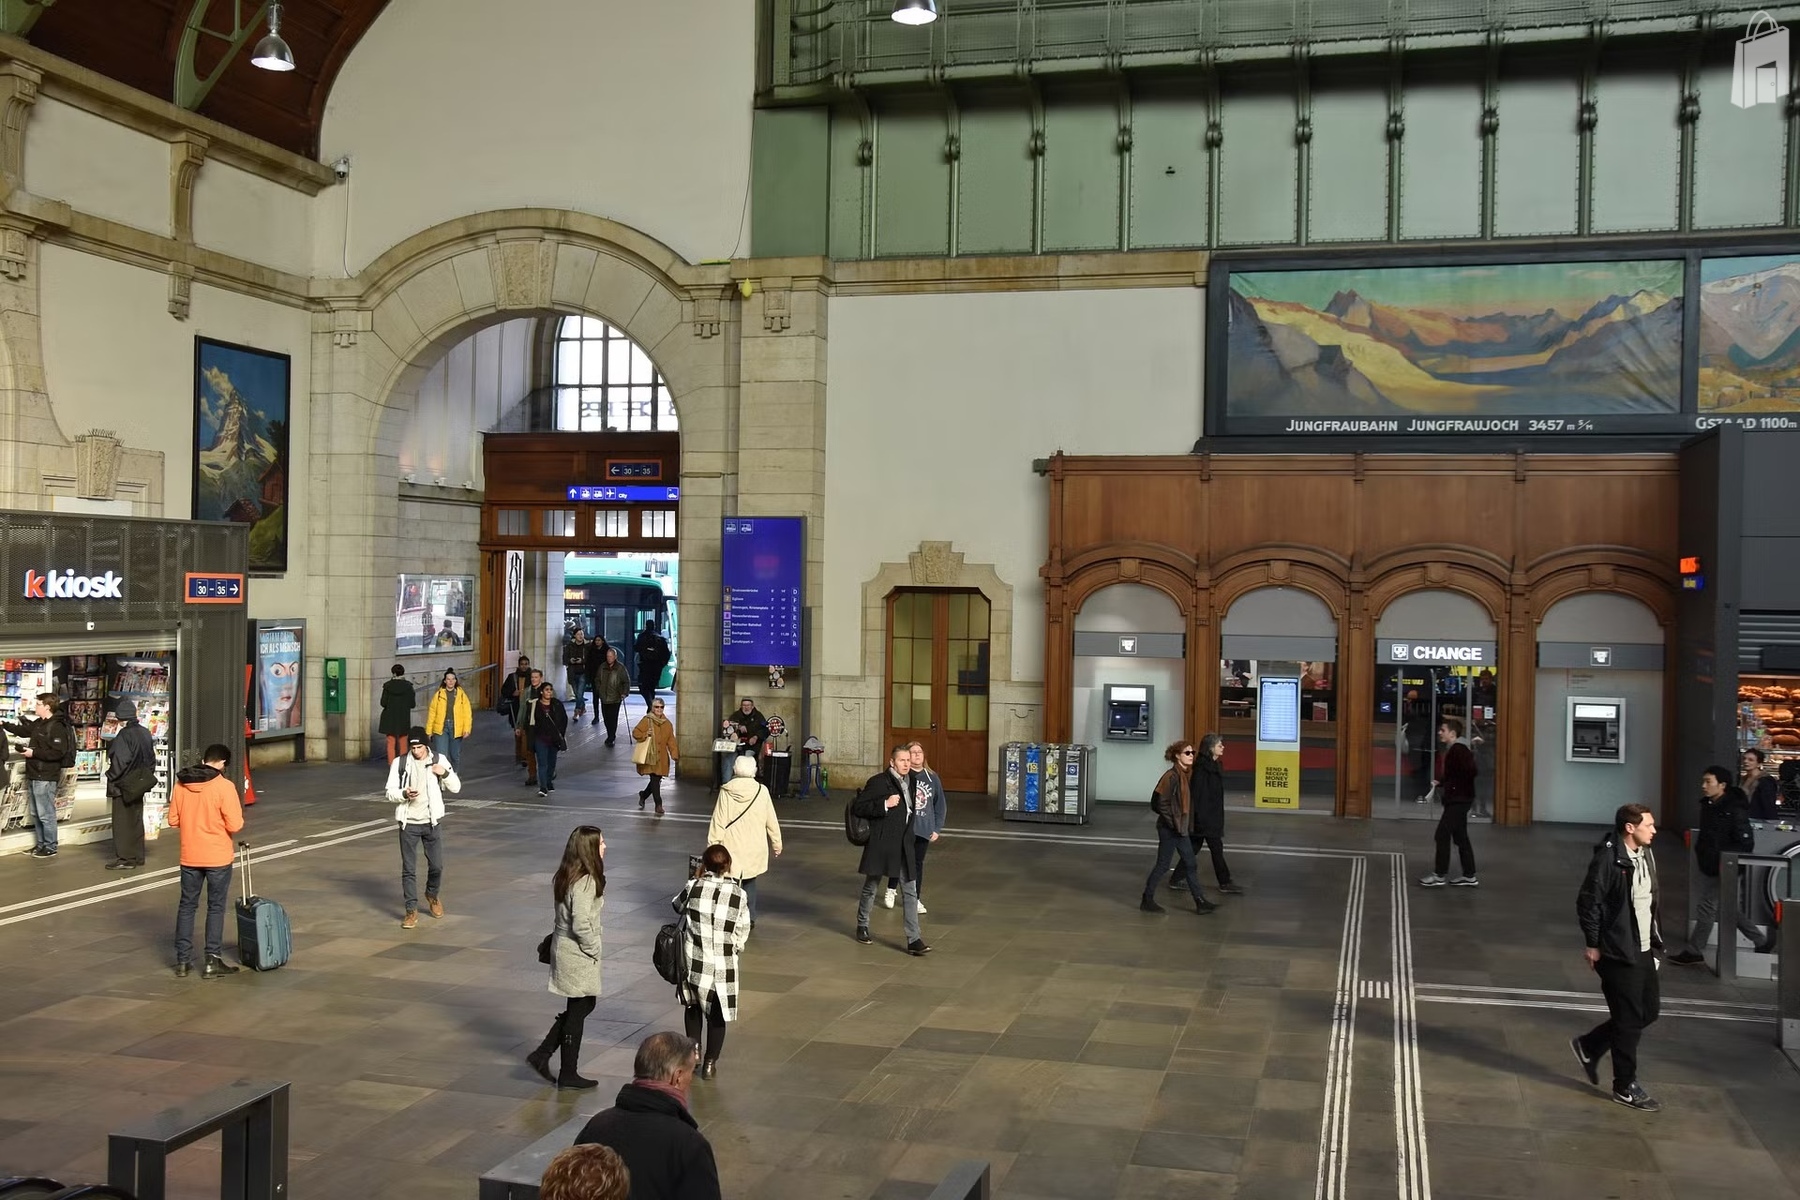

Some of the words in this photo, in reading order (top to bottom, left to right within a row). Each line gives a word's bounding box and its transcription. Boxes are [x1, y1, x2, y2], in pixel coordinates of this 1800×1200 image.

[1528, 419, 1564, 431] 3457
[24, 569, 46, 598] k
[46, 568, 123, 598] kiosk
[197, 585, 207, 595] 30
[217, 585, 226, 595] 35
[269, 642, 280, 654] ALS
[280, 641, 301, 653] MENSCH
[1413, 645, 1483, 661] CHANGE
[1265, 780, 1289, 788] HERE
